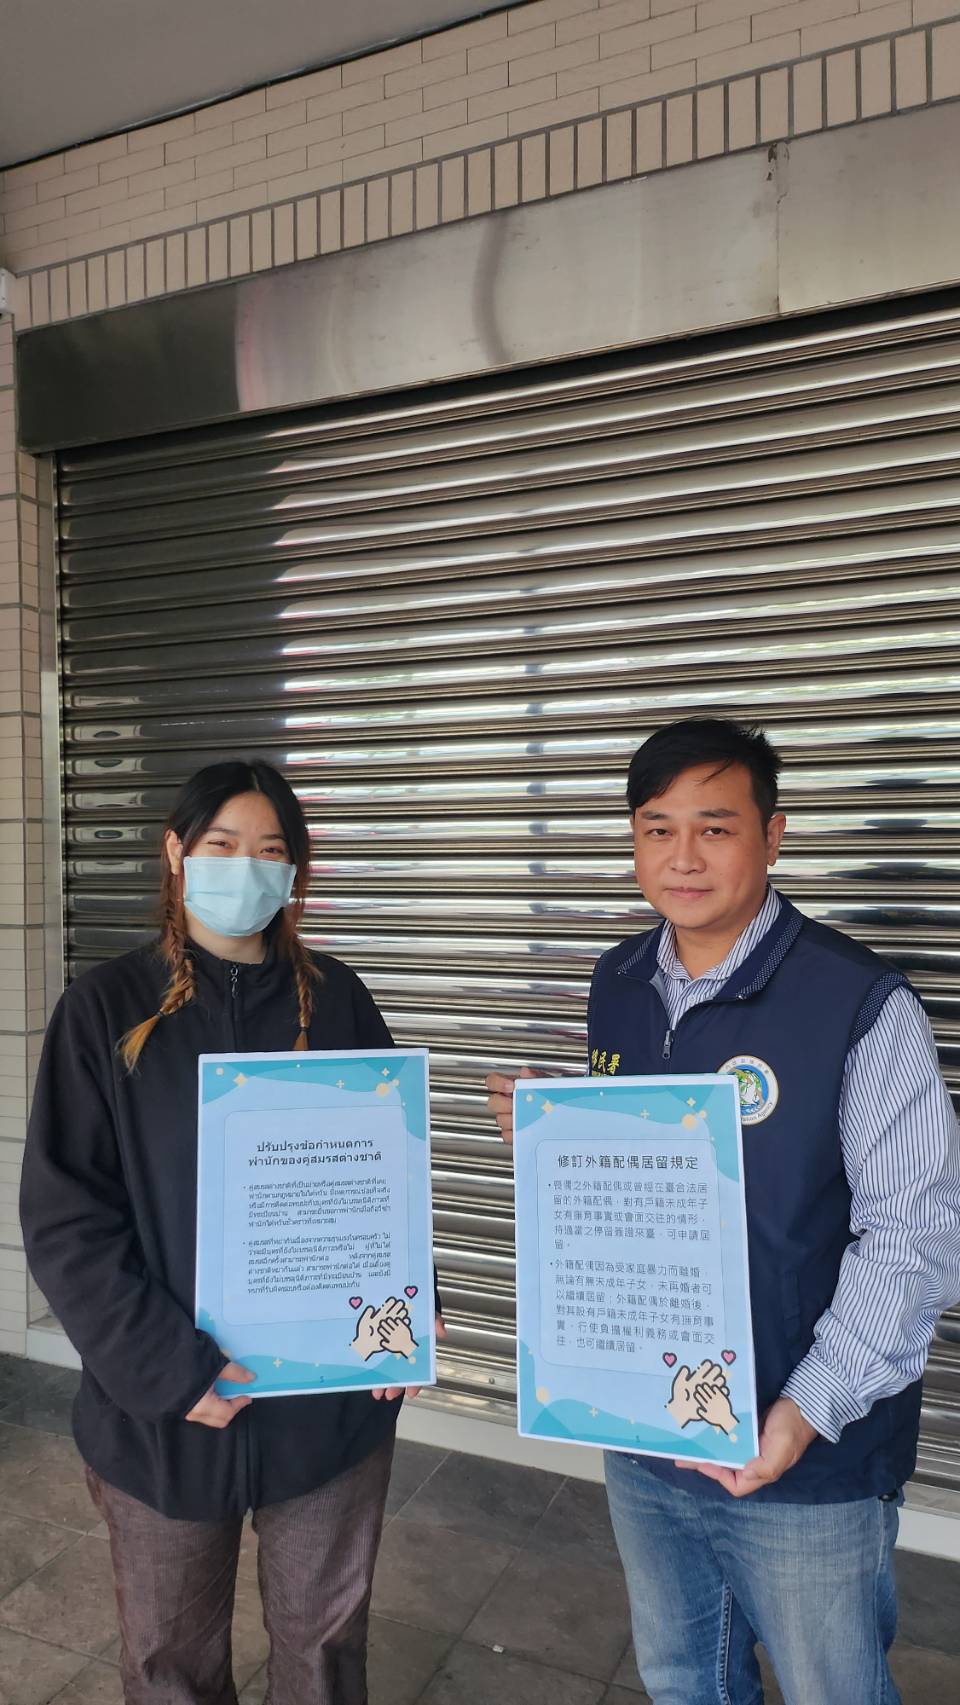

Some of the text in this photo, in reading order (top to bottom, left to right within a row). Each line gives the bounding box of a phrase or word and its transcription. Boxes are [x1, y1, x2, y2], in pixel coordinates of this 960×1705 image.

[257, 1140, 374, 1154] ปรับปรุงข้อกำหนดการ
[248, 1151, 382, 1167] พำนักของคู่สมรสต่างชาติ
[558, 1154, 699, 1170] 修訂外籍配偶居留規定
